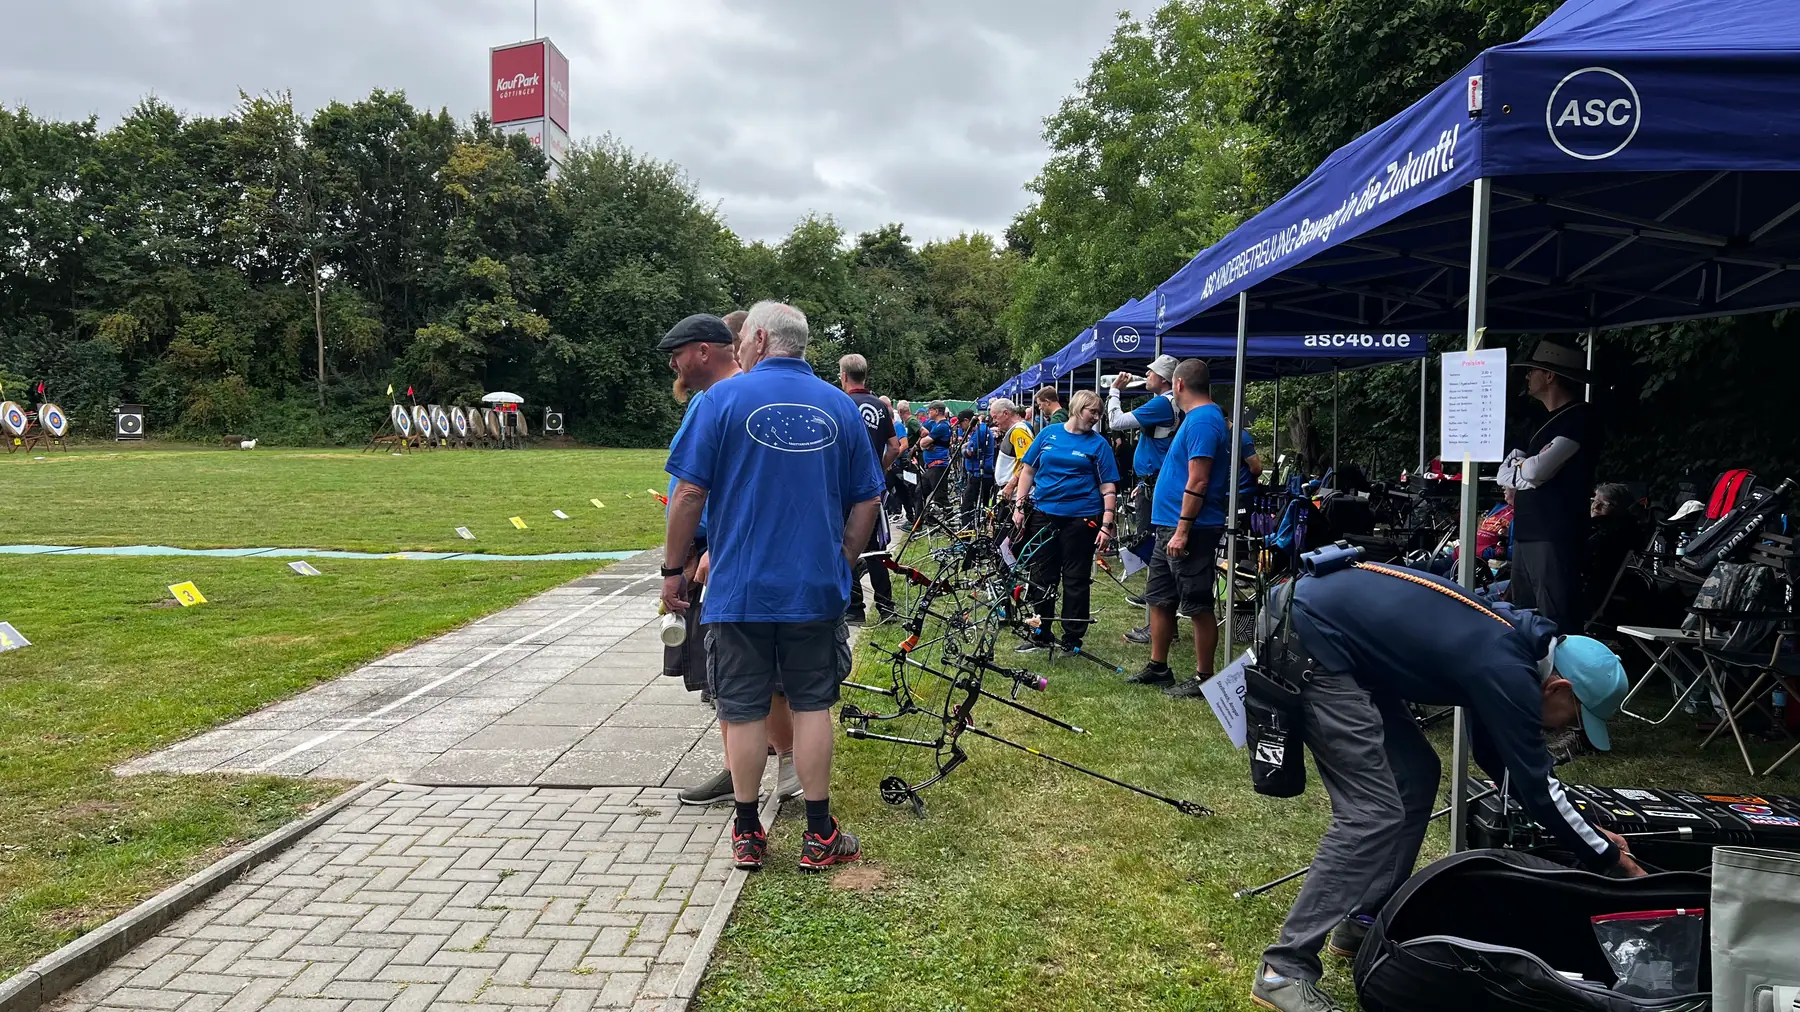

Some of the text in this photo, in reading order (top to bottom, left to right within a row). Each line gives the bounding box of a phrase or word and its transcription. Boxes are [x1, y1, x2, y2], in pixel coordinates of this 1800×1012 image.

[500, 89, 535, 98] GÖTTINGEN
[1556, 98, 1632, 127] ASC
[1200, 123, 1460, 300] ASC KINDERBETREUUNG Bewegt in die Zukunft!
[1115, 334, 1137, 344] ASC
[1304, 333, 1411, 347] asc46.de
[1718, 514, 1763, 558] AVALON
[182, 590, 195, 602] 3
